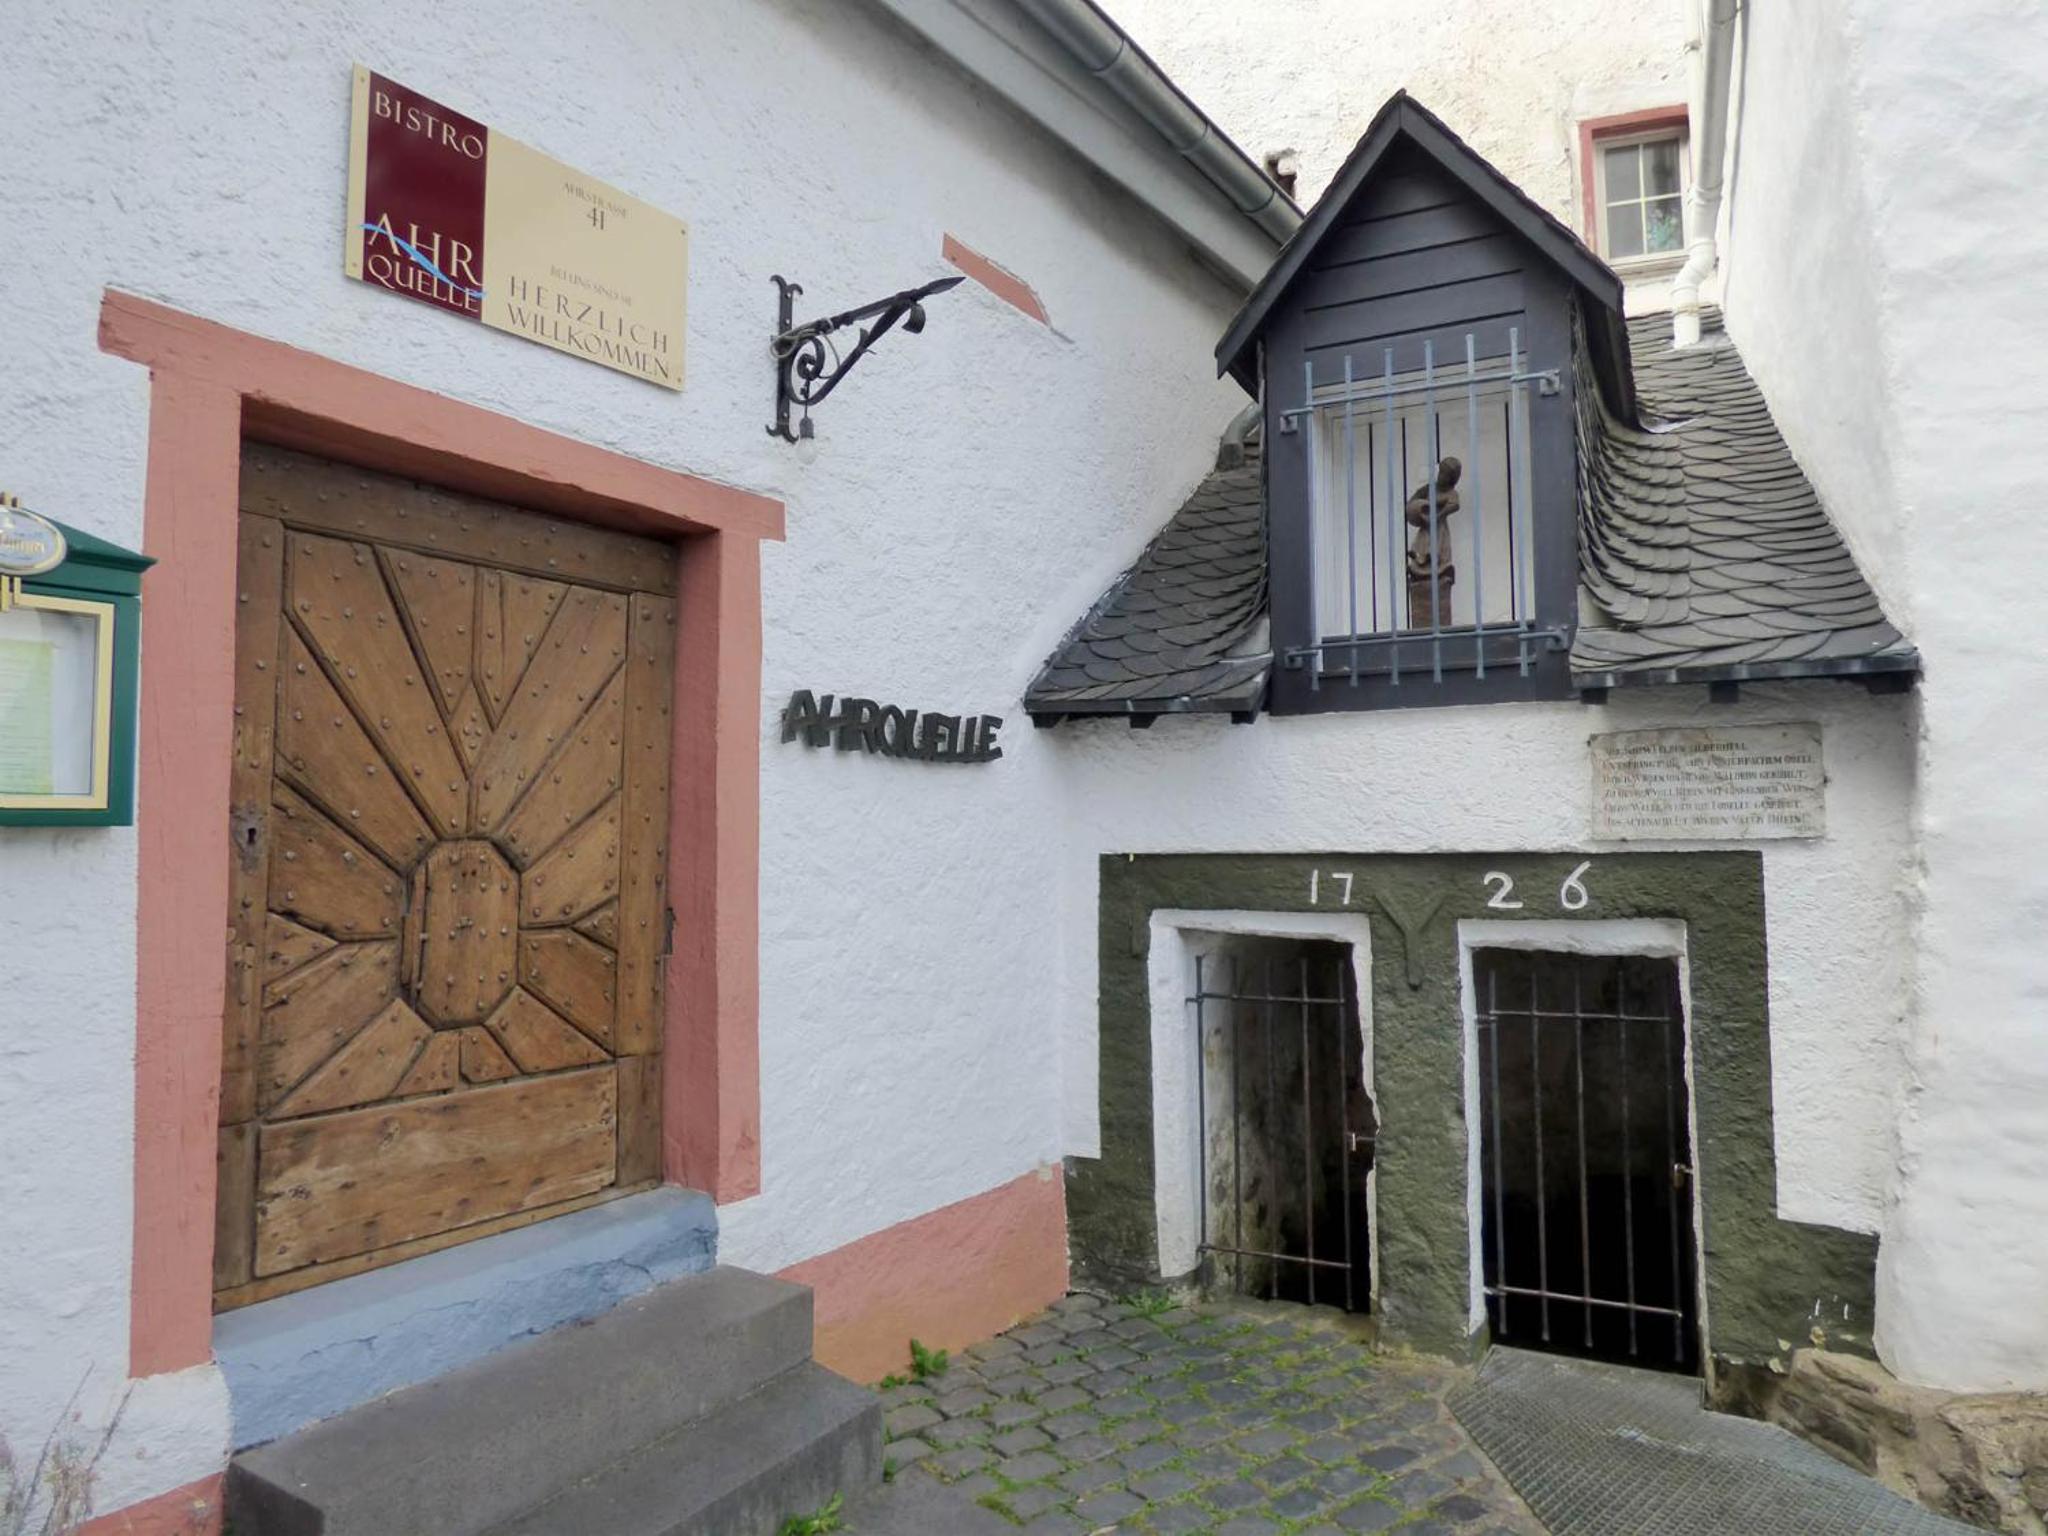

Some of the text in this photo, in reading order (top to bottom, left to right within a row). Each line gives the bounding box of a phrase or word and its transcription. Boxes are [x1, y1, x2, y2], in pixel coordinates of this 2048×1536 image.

[374, 91, 484, 160] BISTRO
[368, 212, 483, 286] AHR
[587, 207, 605, 231] 41
[367, 254, 479, 313] QUELLE
[510, 276, 669, 354] HERZLICH
[507, 303, 670, 380] WILLKOMMEN
[1311, 869, 1353, 904] 17
